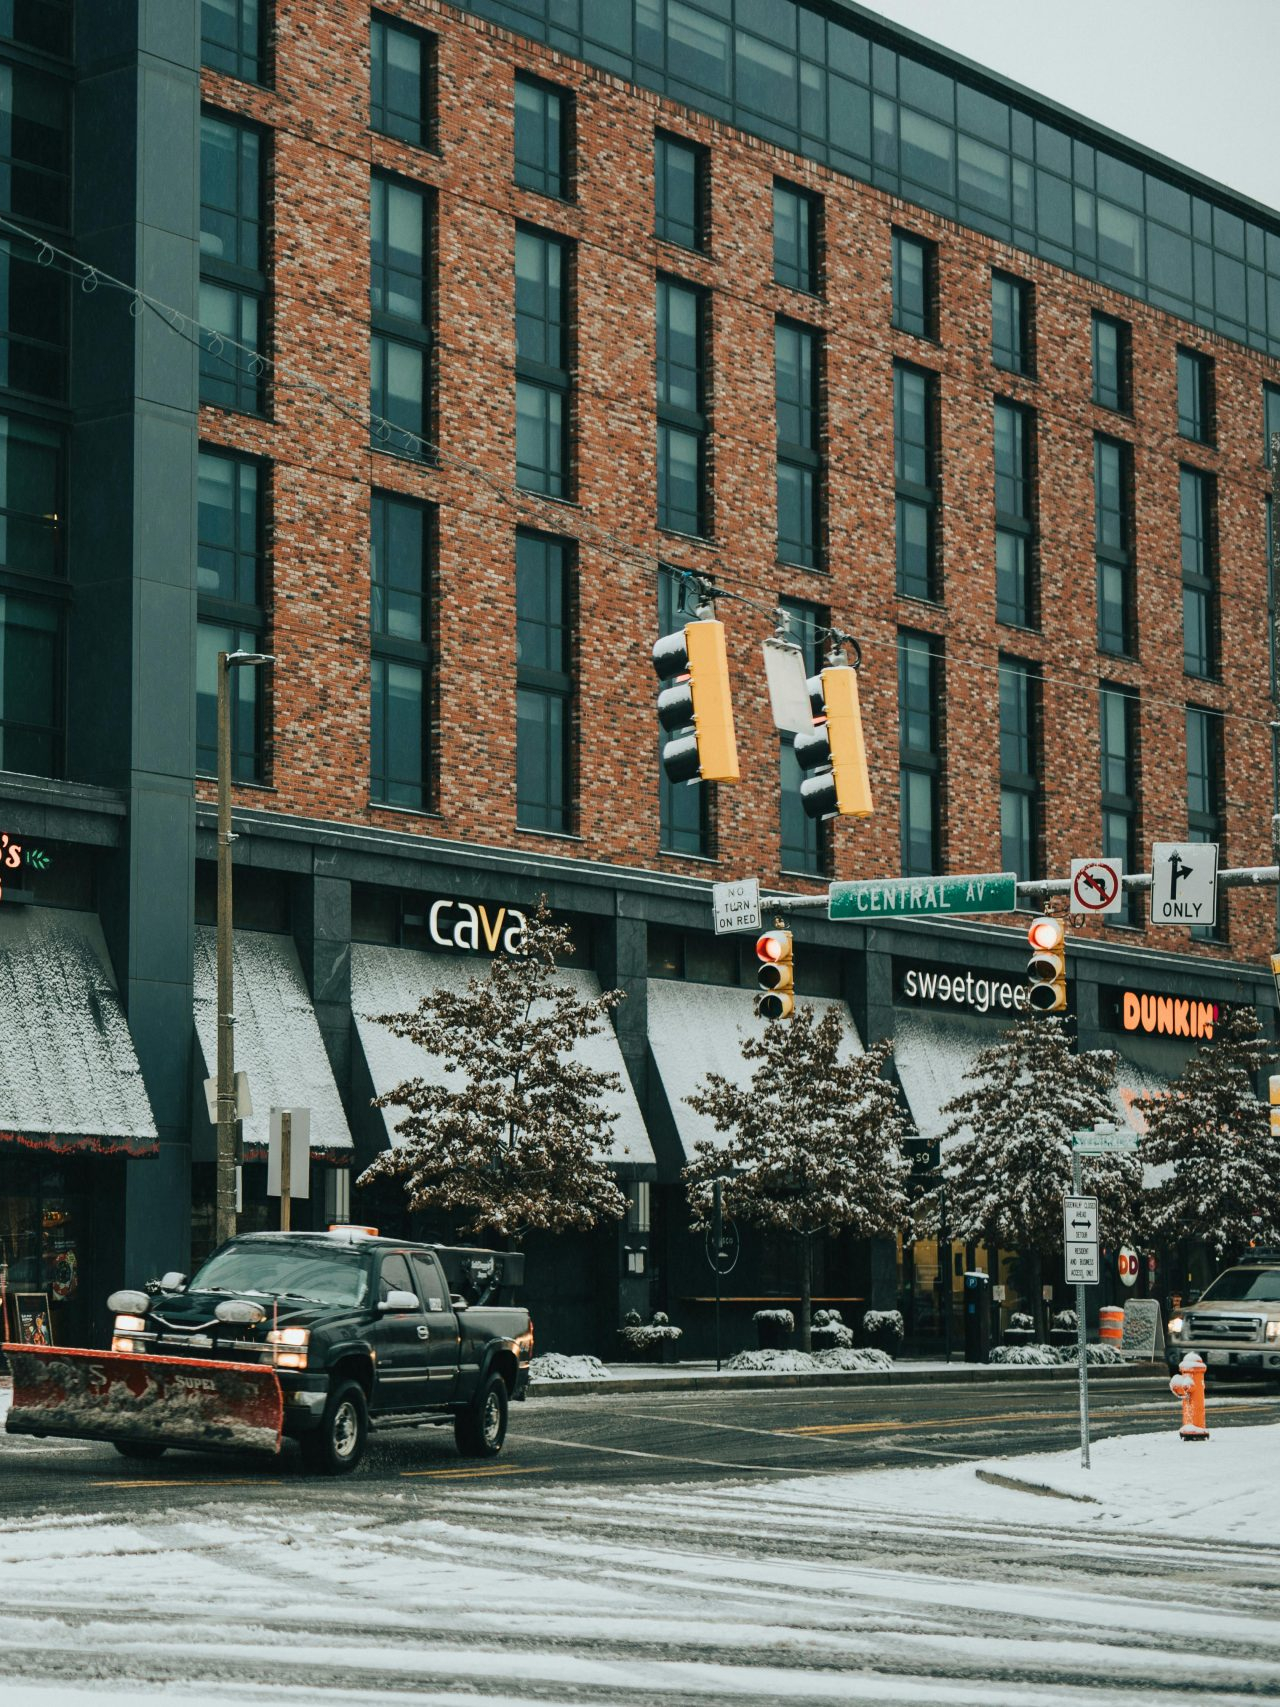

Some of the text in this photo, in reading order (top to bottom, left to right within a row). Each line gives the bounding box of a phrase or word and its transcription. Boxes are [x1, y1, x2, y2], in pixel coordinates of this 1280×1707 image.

[728, 887, 744, 897] NO
[857, 881, 986, 912] CENTRAL AV
[725, 900, 750, 912] TURN
[1163, 902, 1203, 918] ONLY
[720, 914, 756, 928] ON RED
[905, 970, 1030, 1012] sweetgree
[1076, 1231, 1088, 1239] DETOUR
